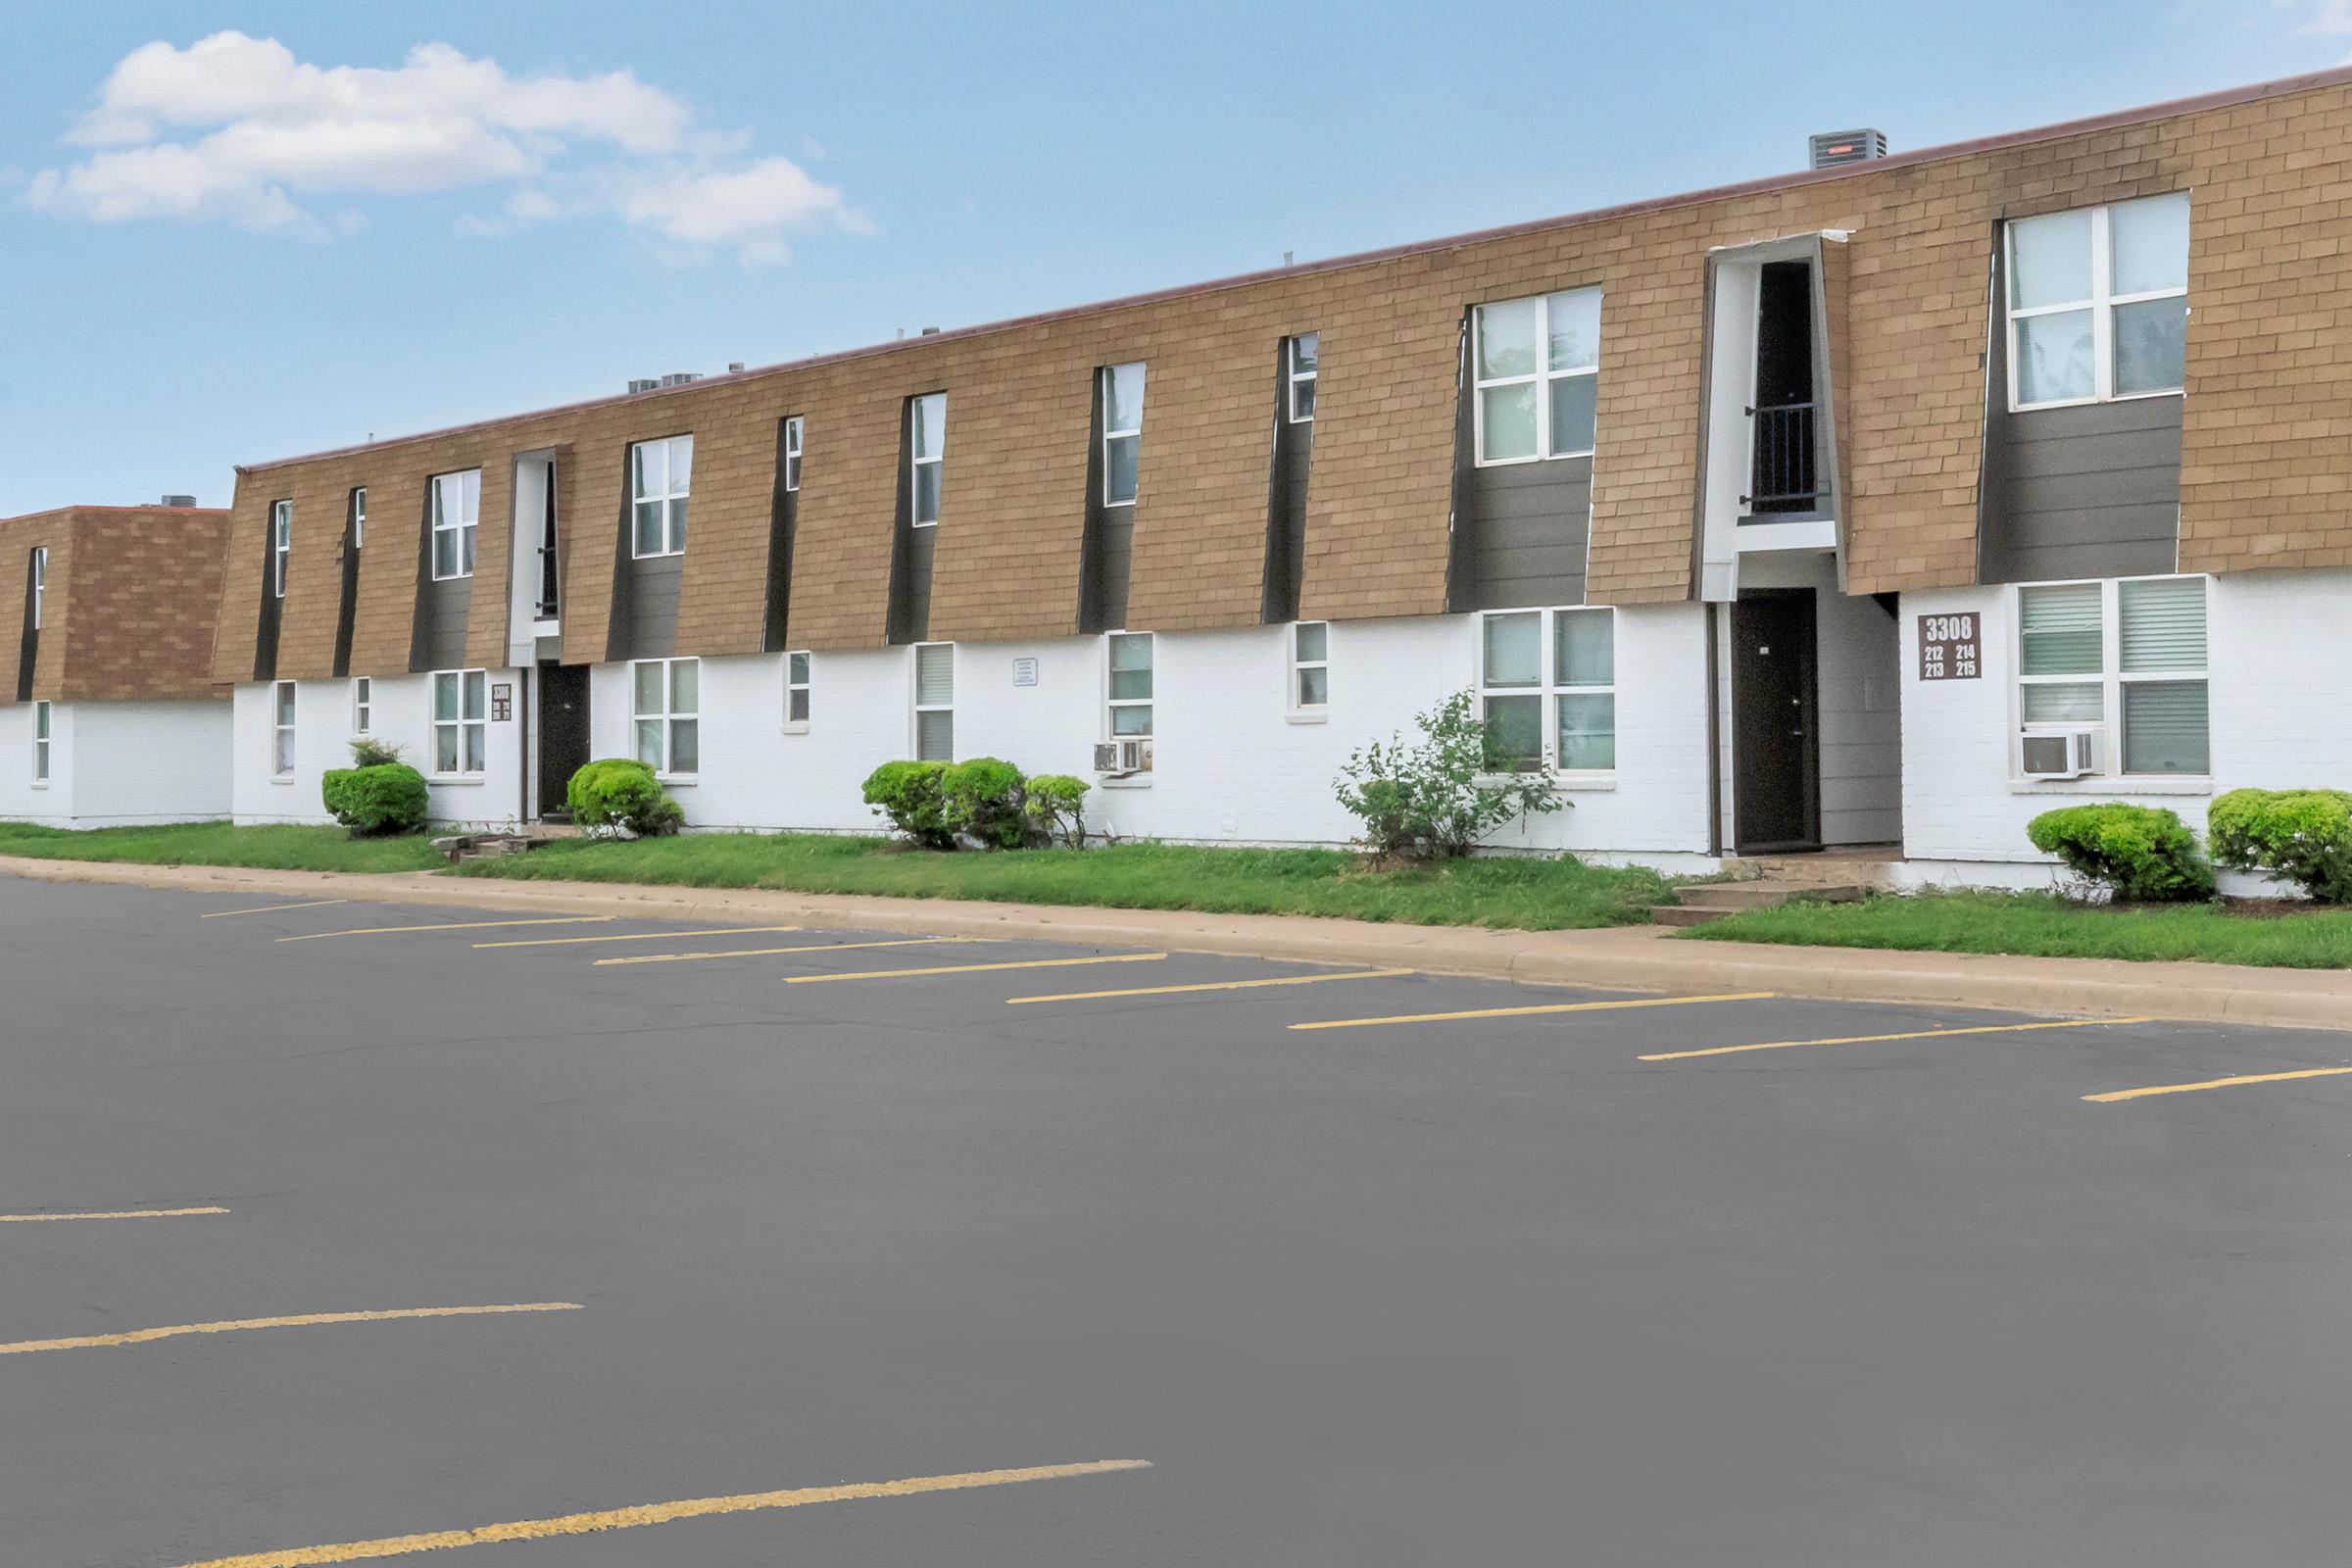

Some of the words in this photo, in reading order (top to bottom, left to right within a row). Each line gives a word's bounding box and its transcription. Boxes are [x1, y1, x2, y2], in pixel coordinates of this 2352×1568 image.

[1926, 615, 1972, 641] 3308
[1925, 646, 1943, 661] 212
[1955, 644, 1975, 659] 214
[1925, 662, 1944, 677] 213
[1956, 661, 1976, 676] 215
